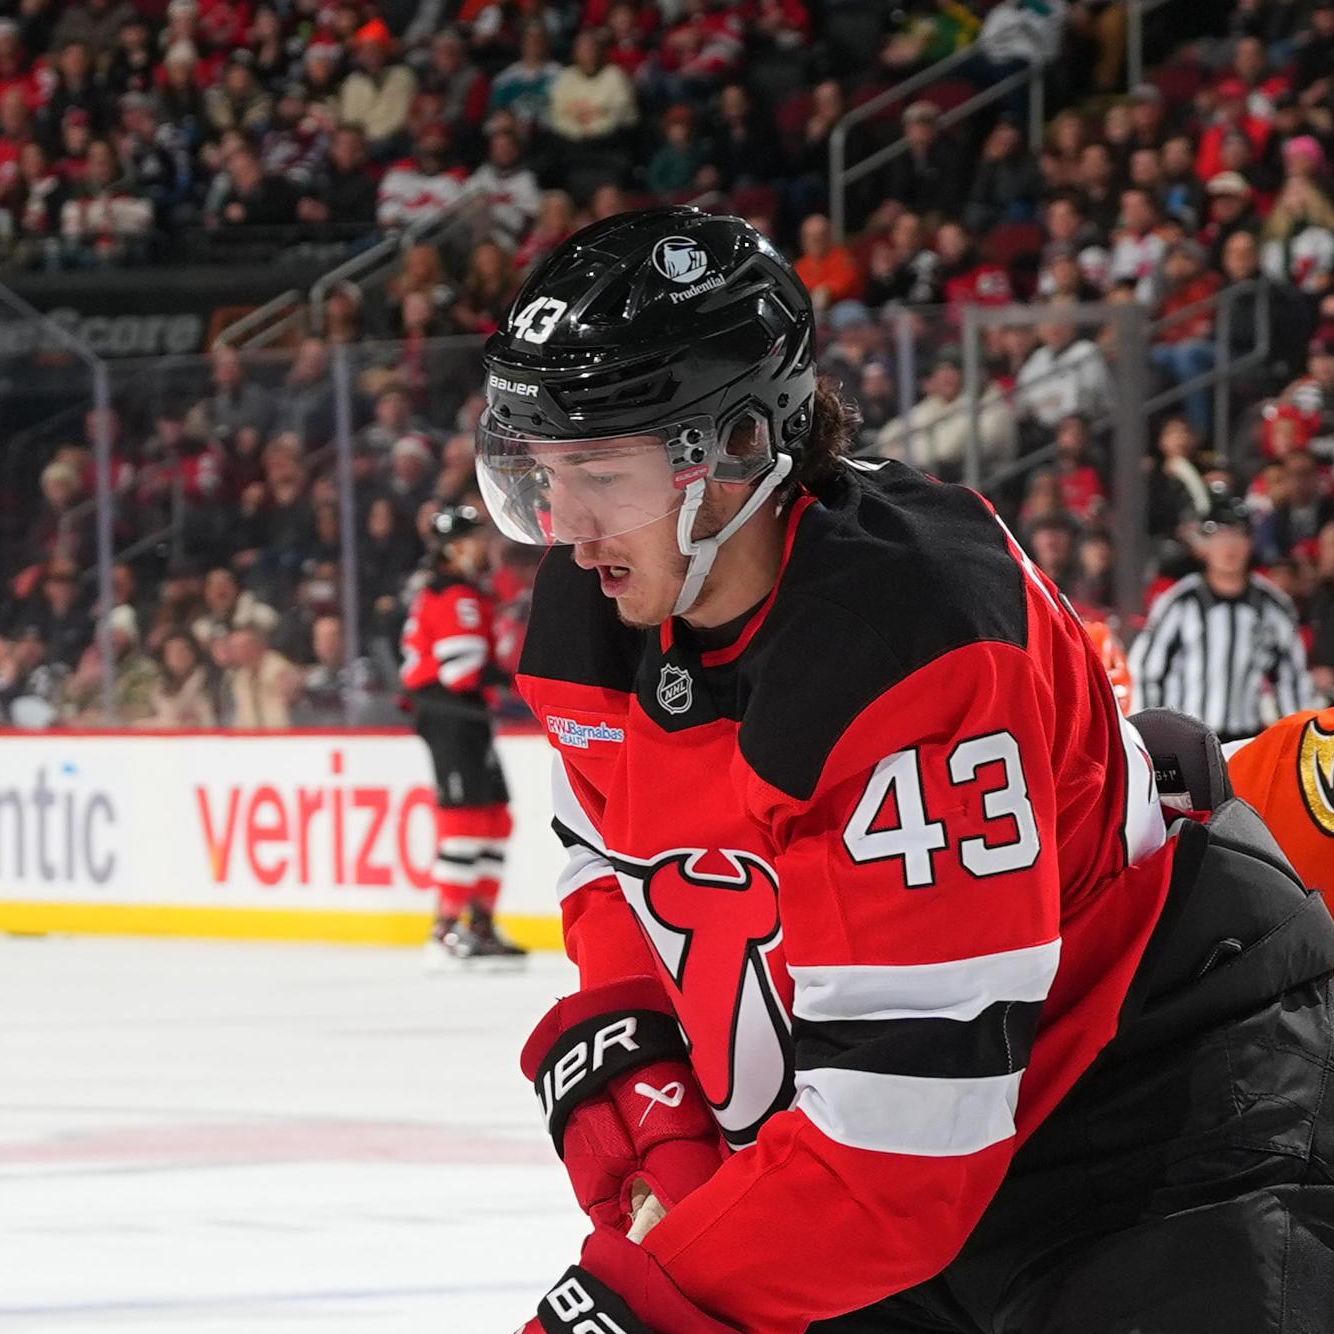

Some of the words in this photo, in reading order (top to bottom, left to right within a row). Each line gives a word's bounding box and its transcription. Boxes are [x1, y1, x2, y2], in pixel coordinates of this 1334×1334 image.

[669, 273, 727, 304] Prudential
[514, 296, 567, 344] 43
[489, 374, 539, 398] BAUER
[664, 682, 687, 701] NHL
[195, 749, 440, 892] verizo
[843, 729, 1042, 890] 43
[537, 1016, 640, 1131] UER
